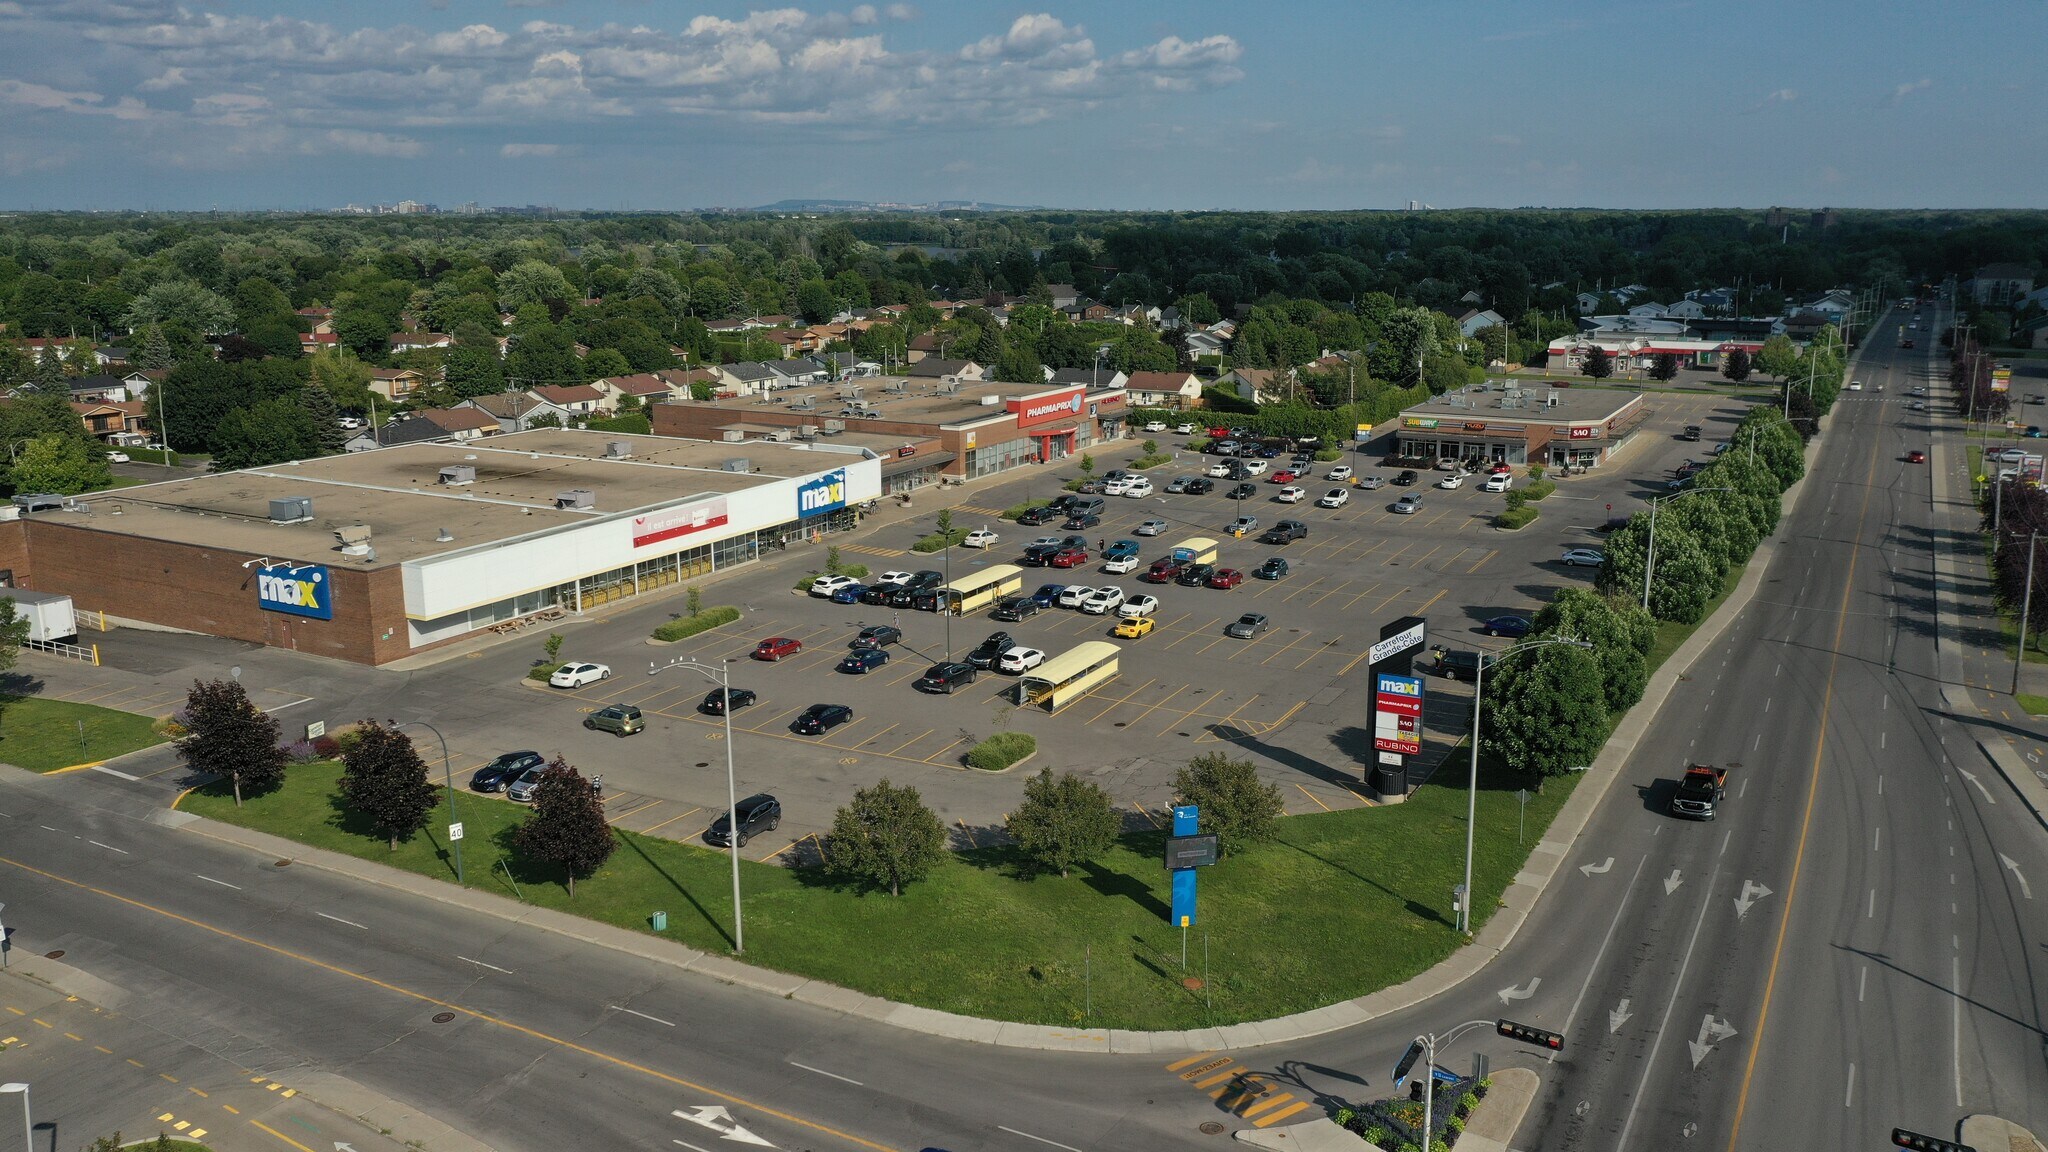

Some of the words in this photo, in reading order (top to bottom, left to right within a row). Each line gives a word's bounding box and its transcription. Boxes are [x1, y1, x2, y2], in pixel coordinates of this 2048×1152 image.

[1027, 400, 1072, 418] PHARMAPRIX
[1407, 418, 1436, 427] SUBWAY
[802, 474, 844, 510] maxi
[654, 518, 665, 530] est
[259, 573, 322, 608] max
[1373, 635, 1422, 661] Grande-Côte
[1374, 631, 1412, 652] Carrefour
[1380, 679, 1419, 696] maxi
[1378, 699, 1413, 709] PHARMAPRIX
[1376, 740, 1418, 753] RUBINO
[451, 828, 462, 838] 40
